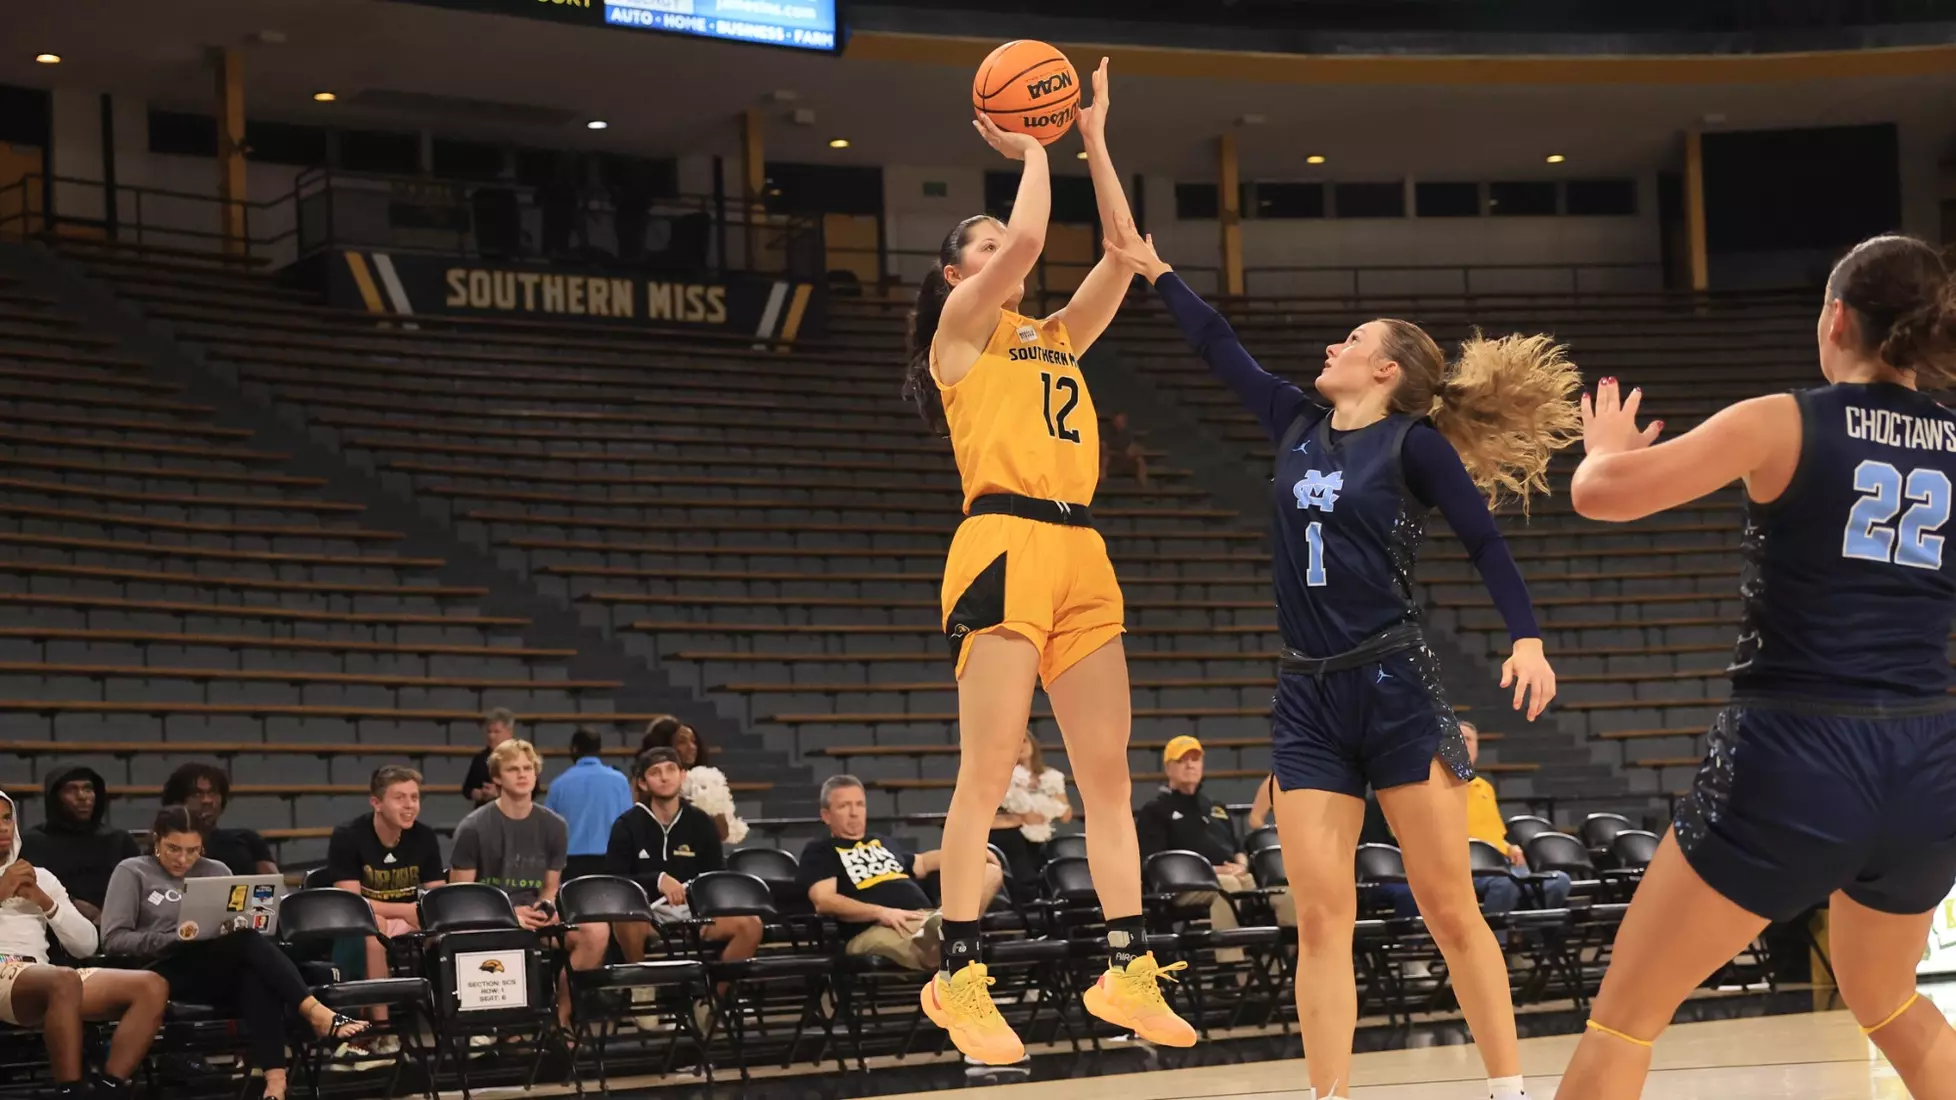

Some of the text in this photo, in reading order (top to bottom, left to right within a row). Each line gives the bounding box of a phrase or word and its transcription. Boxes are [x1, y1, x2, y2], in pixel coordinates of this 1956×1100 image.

[611, 7, 834, 47] AUTO HOME BUSINESS FARM
[1027, 70, 1072, 100] NCAA
[446, 268, 727, 323] SOUTHERN MISS
[1009, 346, 1069, 366] SOUTHERN
[1039, 371, 1081, 444] 12
[1845, 406, 1956, 452] CHOCTAWS
[1842, 459, 1952, 570] 22
[1305, 521, 1327, 586] 1
[838, 845, 896, 868] RUN
[505, 878, 543, 889] FLOYD
